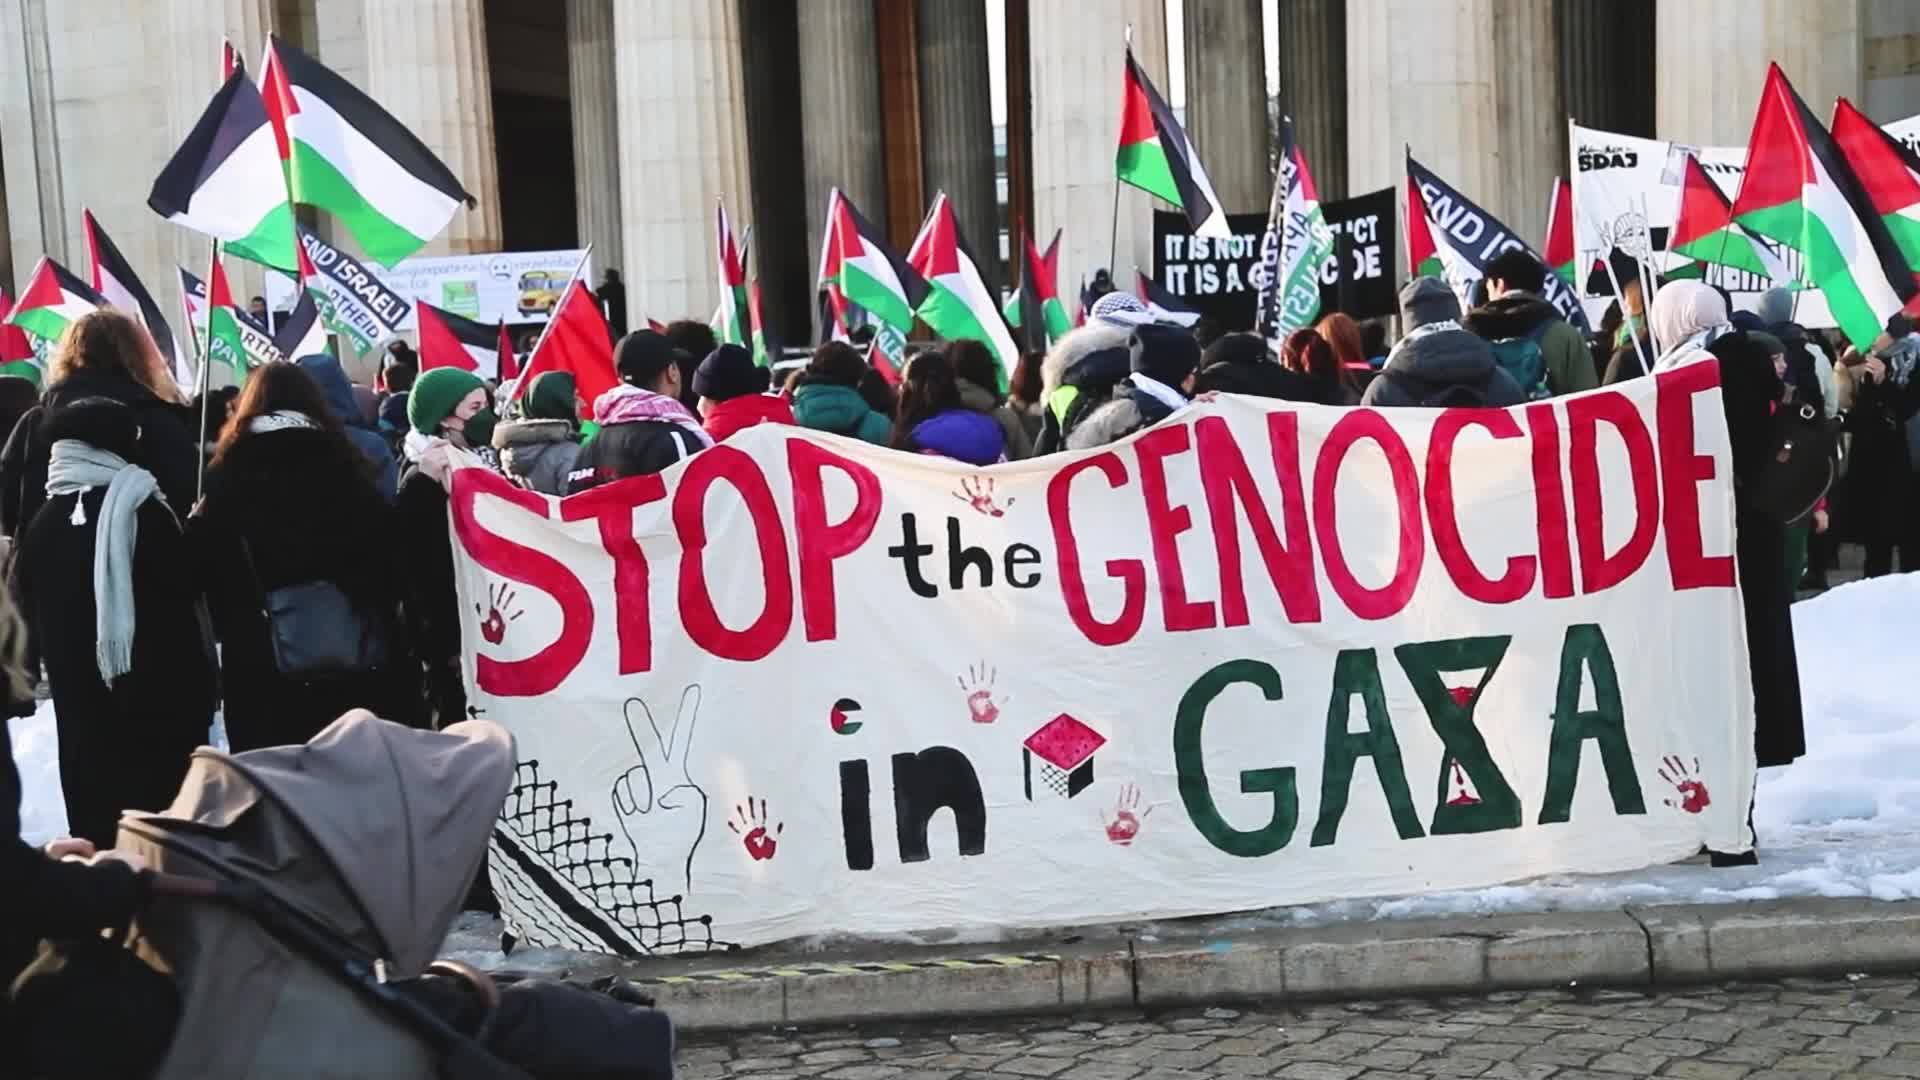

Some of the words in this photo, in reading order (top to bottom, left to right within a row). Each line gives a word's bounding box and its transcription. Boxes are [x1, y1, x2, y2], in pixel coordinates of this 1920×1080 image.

[1577, 153, 1639, 172] SDAJ
[1422, 182, 1485, 244] END
[1165, 234, 1185, 260] IT
[1188, 234, 1210, 260] IS
[1215, 233, 1256, 260] NOT
[333, 259, 405, 323] ISRAELI
[1165, 264, 1188, 296] IT
[1194, 263, 1220, 294] IS
[1225, 262, 1245, 294] A
[451, 437, 882, 697] STOP
[889, 512, 1041, 598] the
[1047, 359, 1737, 647] GENOCIDE
[830, 698, 987, 871] in
[1174, 623, 1648, 858] GAZA
